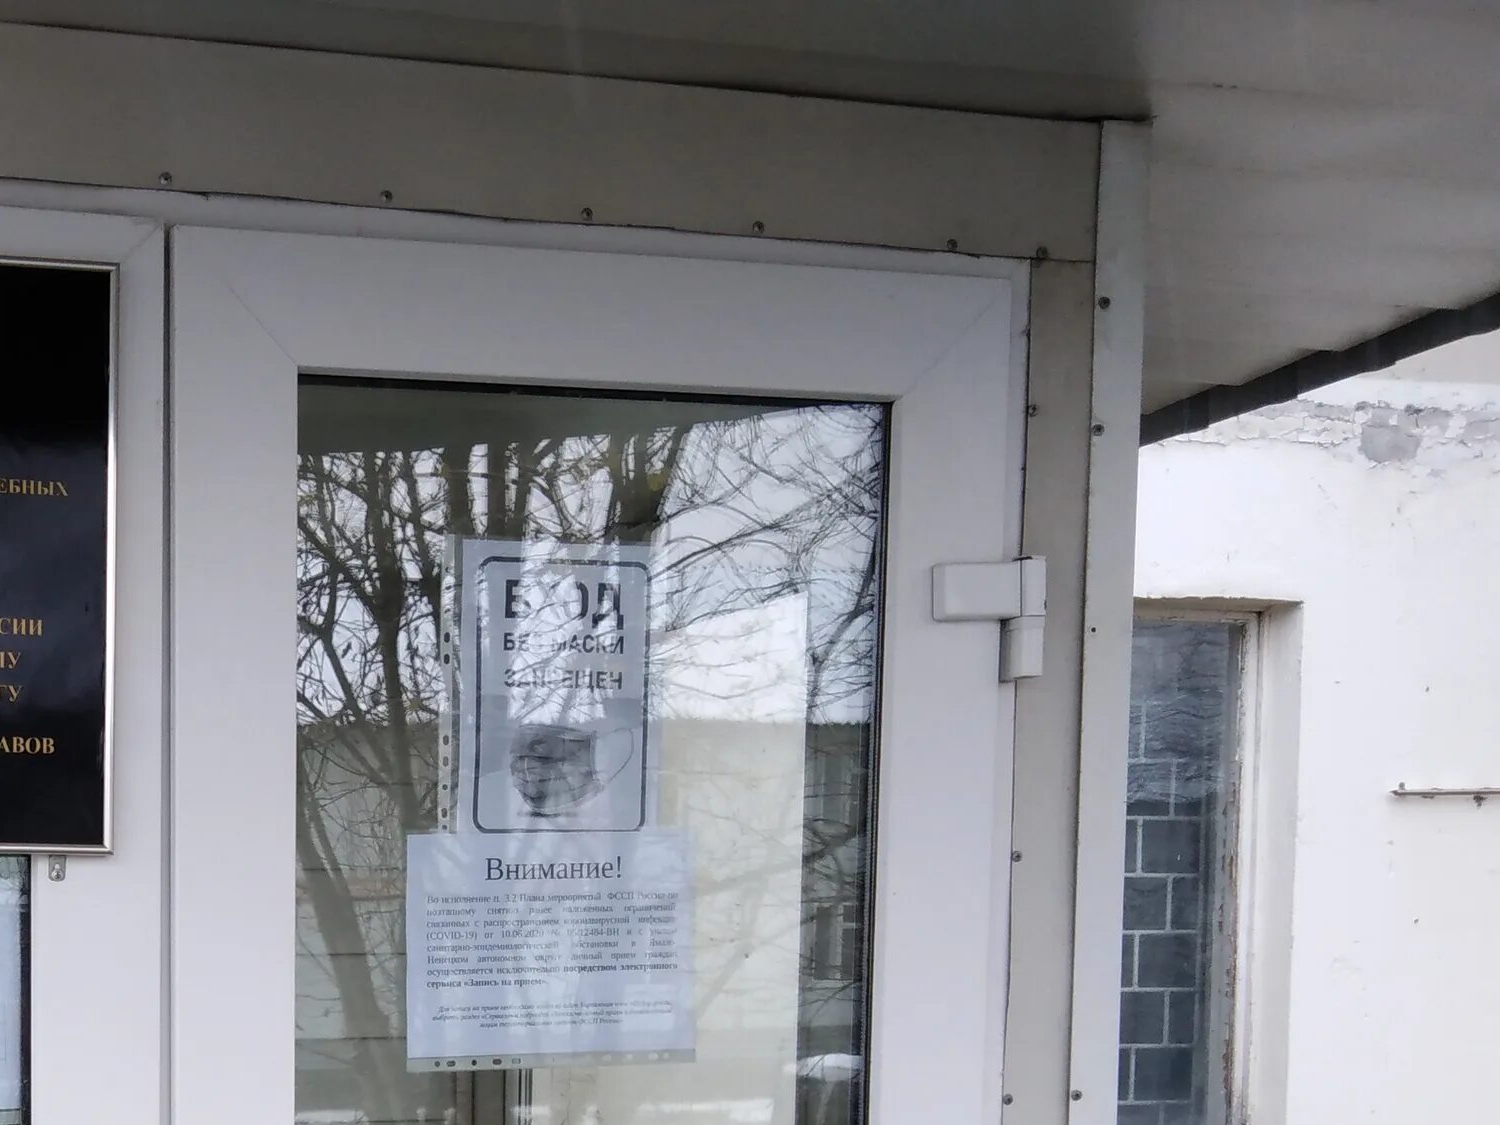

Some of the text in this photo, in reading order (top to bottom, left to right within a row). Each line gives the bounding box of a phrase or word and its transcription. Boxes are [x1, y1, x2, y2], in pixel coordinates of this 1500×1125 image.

[485, 856, 621, 880] Внимание!
[520, 893, 545, 902] Плана
[607, 891, 634, 900] ФССП
[426, 931, 477, 940] (COVID-19)
[484, 932, 494, 940] от
[563, 964, 617, 975] посредством
